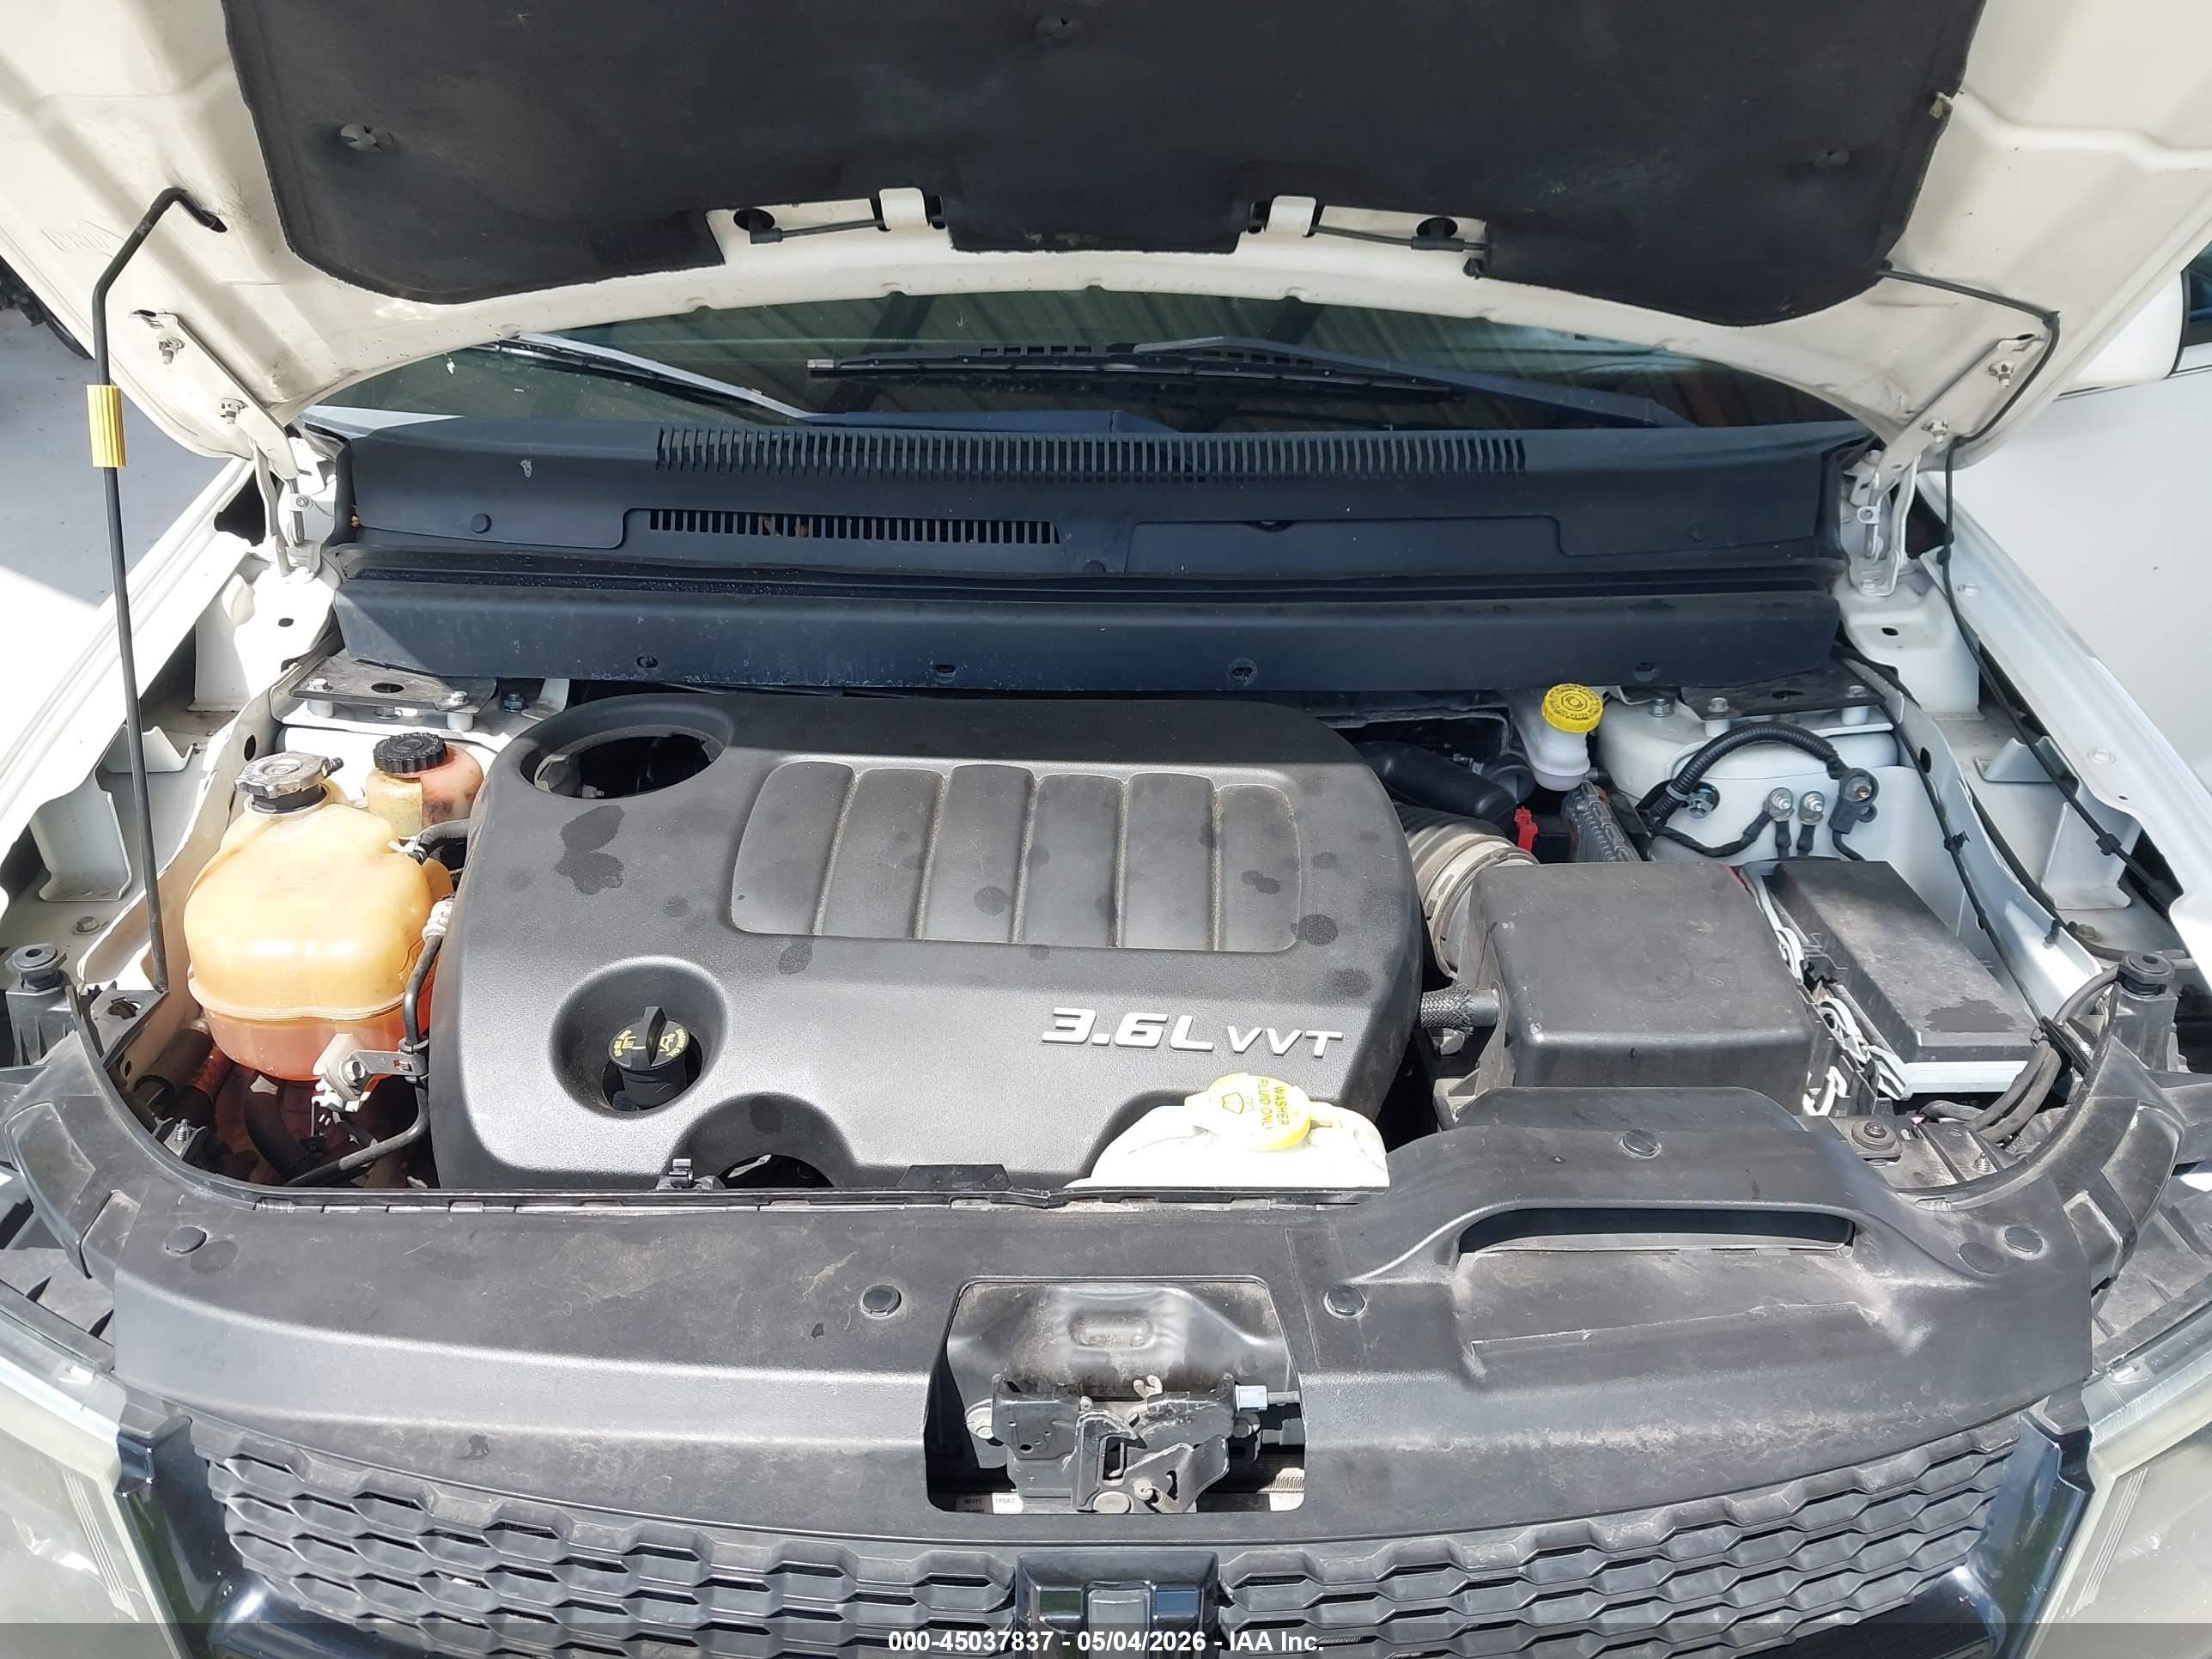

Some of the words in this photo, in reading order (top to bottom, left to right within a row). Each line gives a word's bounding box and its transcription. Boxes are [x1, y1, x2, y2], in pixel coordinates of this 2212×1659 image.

[675, 1029, 686, 1048] ENGINE
[1042, 1007, 1214, 1053] 3.6L
[1227, 1025, 1343, 1059] VVT
[665, 1048, 680, 1057] OIL
[1257, 1079, 1271, 1106] FLUID
[1273, 1085, 1290, 1126] WASHER
